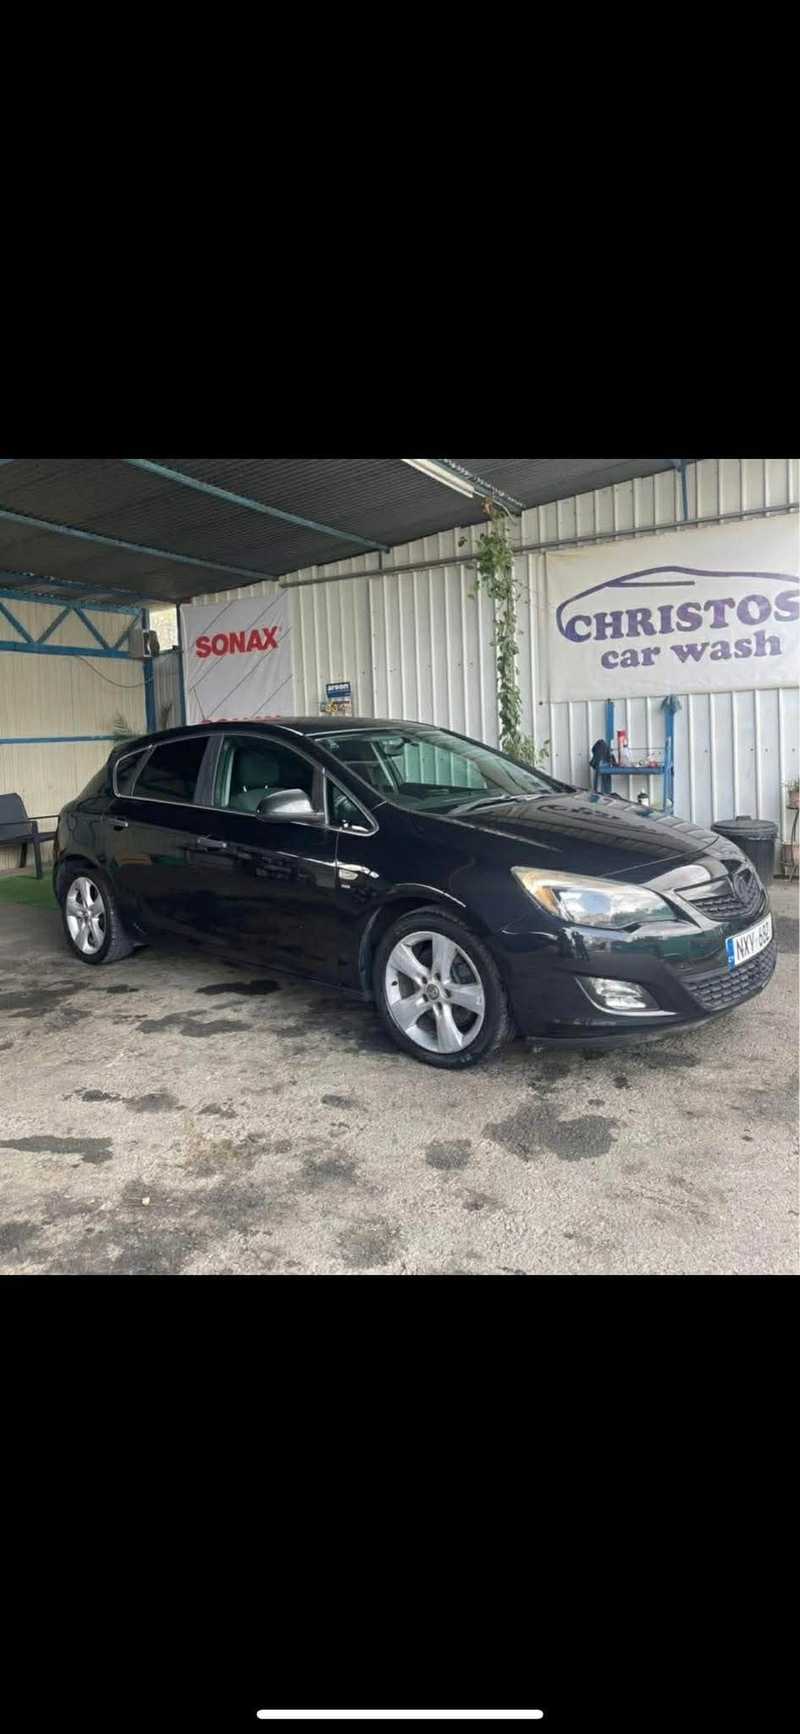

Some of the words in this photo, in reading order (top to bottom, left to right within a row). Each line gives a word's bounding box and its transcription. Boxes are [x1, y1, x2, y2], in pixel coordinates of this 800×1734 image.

[565, 589, 800, 643] CHRISTOS
[196, 626, 279, 658] SONAX
[601, 646, 661, 669] car
[670, 630, 782, 663] wash
